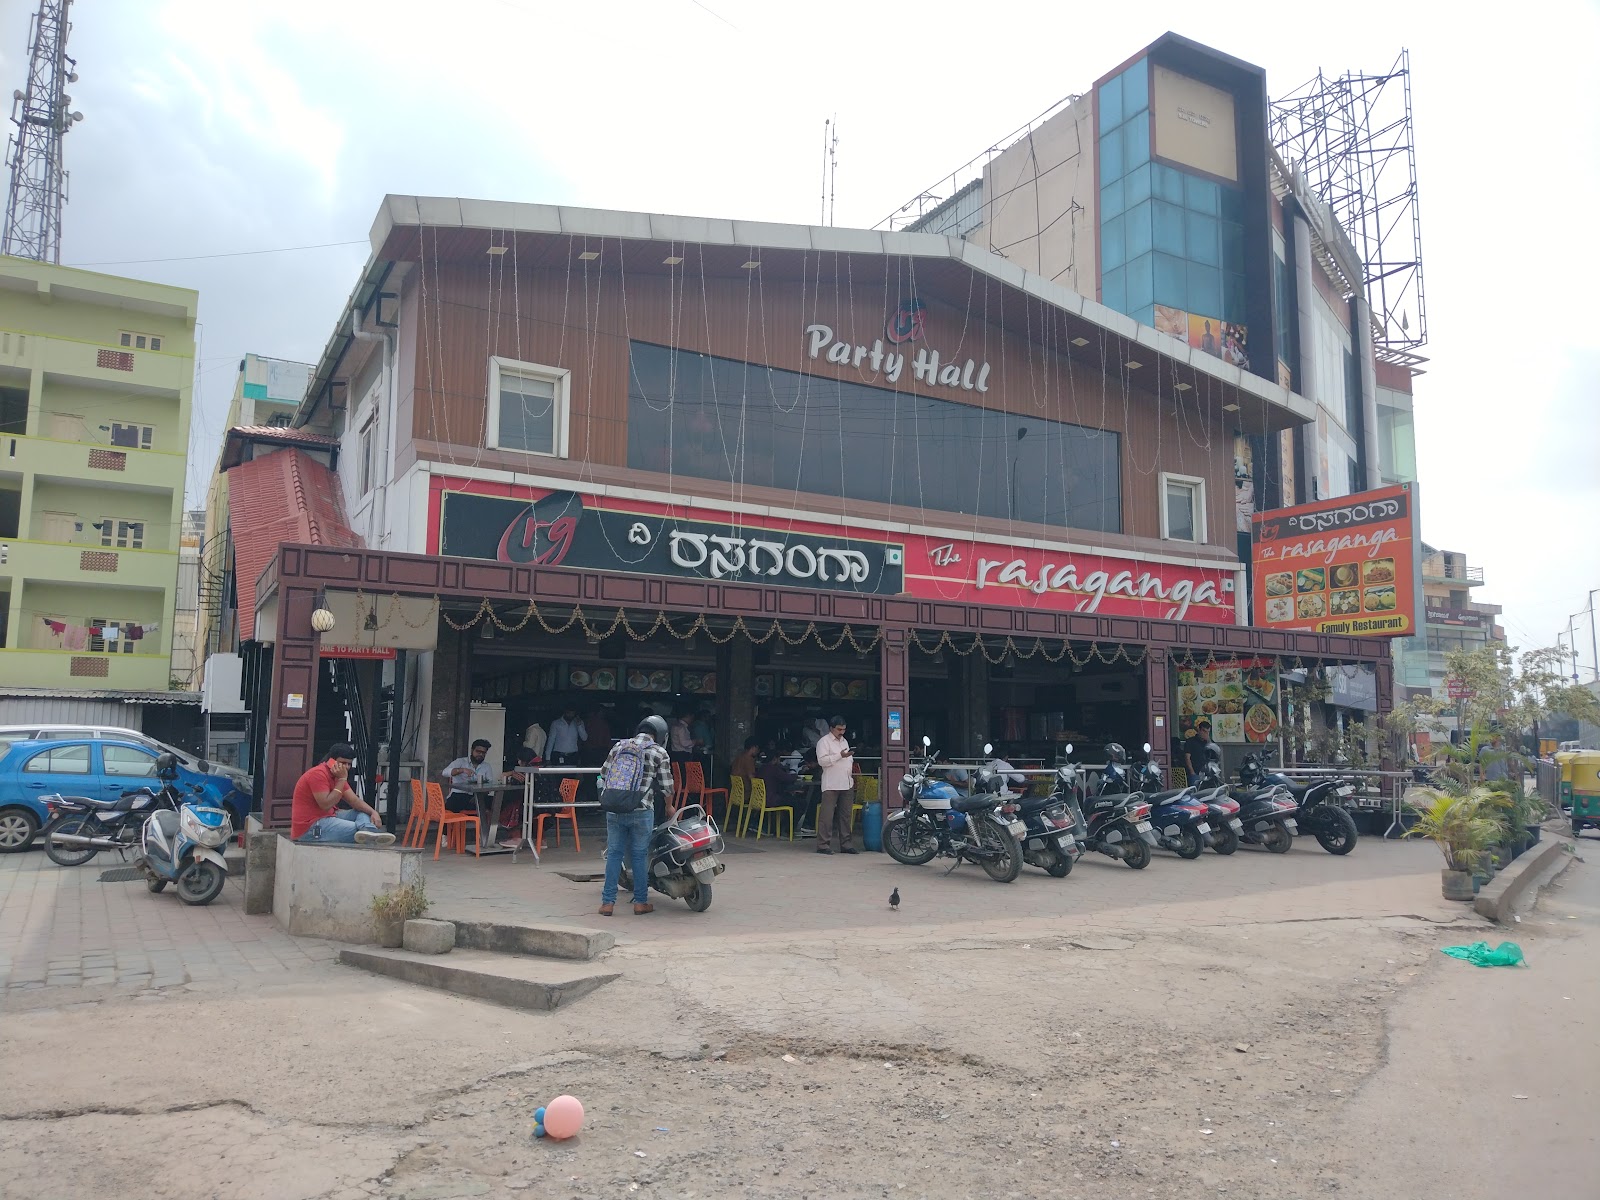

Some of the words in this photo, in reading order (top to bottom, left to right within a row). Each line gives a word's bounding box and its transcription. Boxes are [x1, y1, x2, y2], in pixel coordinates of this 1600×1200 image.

[804, 324, 904, 384] Party
[911, 348, 991, 393] Hall
[627, 521, 651, 546] ದಿ
[669, 528, 870, 583] ರಸಗಂಗಾ
[1261, 546, 1275, 559] The
[1281, 527, 1400, 564] rasaganga
[928, 543, 962, 567] The
[975, 556, 1222, 621] rasaganga
[1352, 616, 1403, 632] Restaurant
[337, 645, 347, 653] TO
[347, 646, 370, 654] PARTY
[372, 646, 390, 655] HALL
